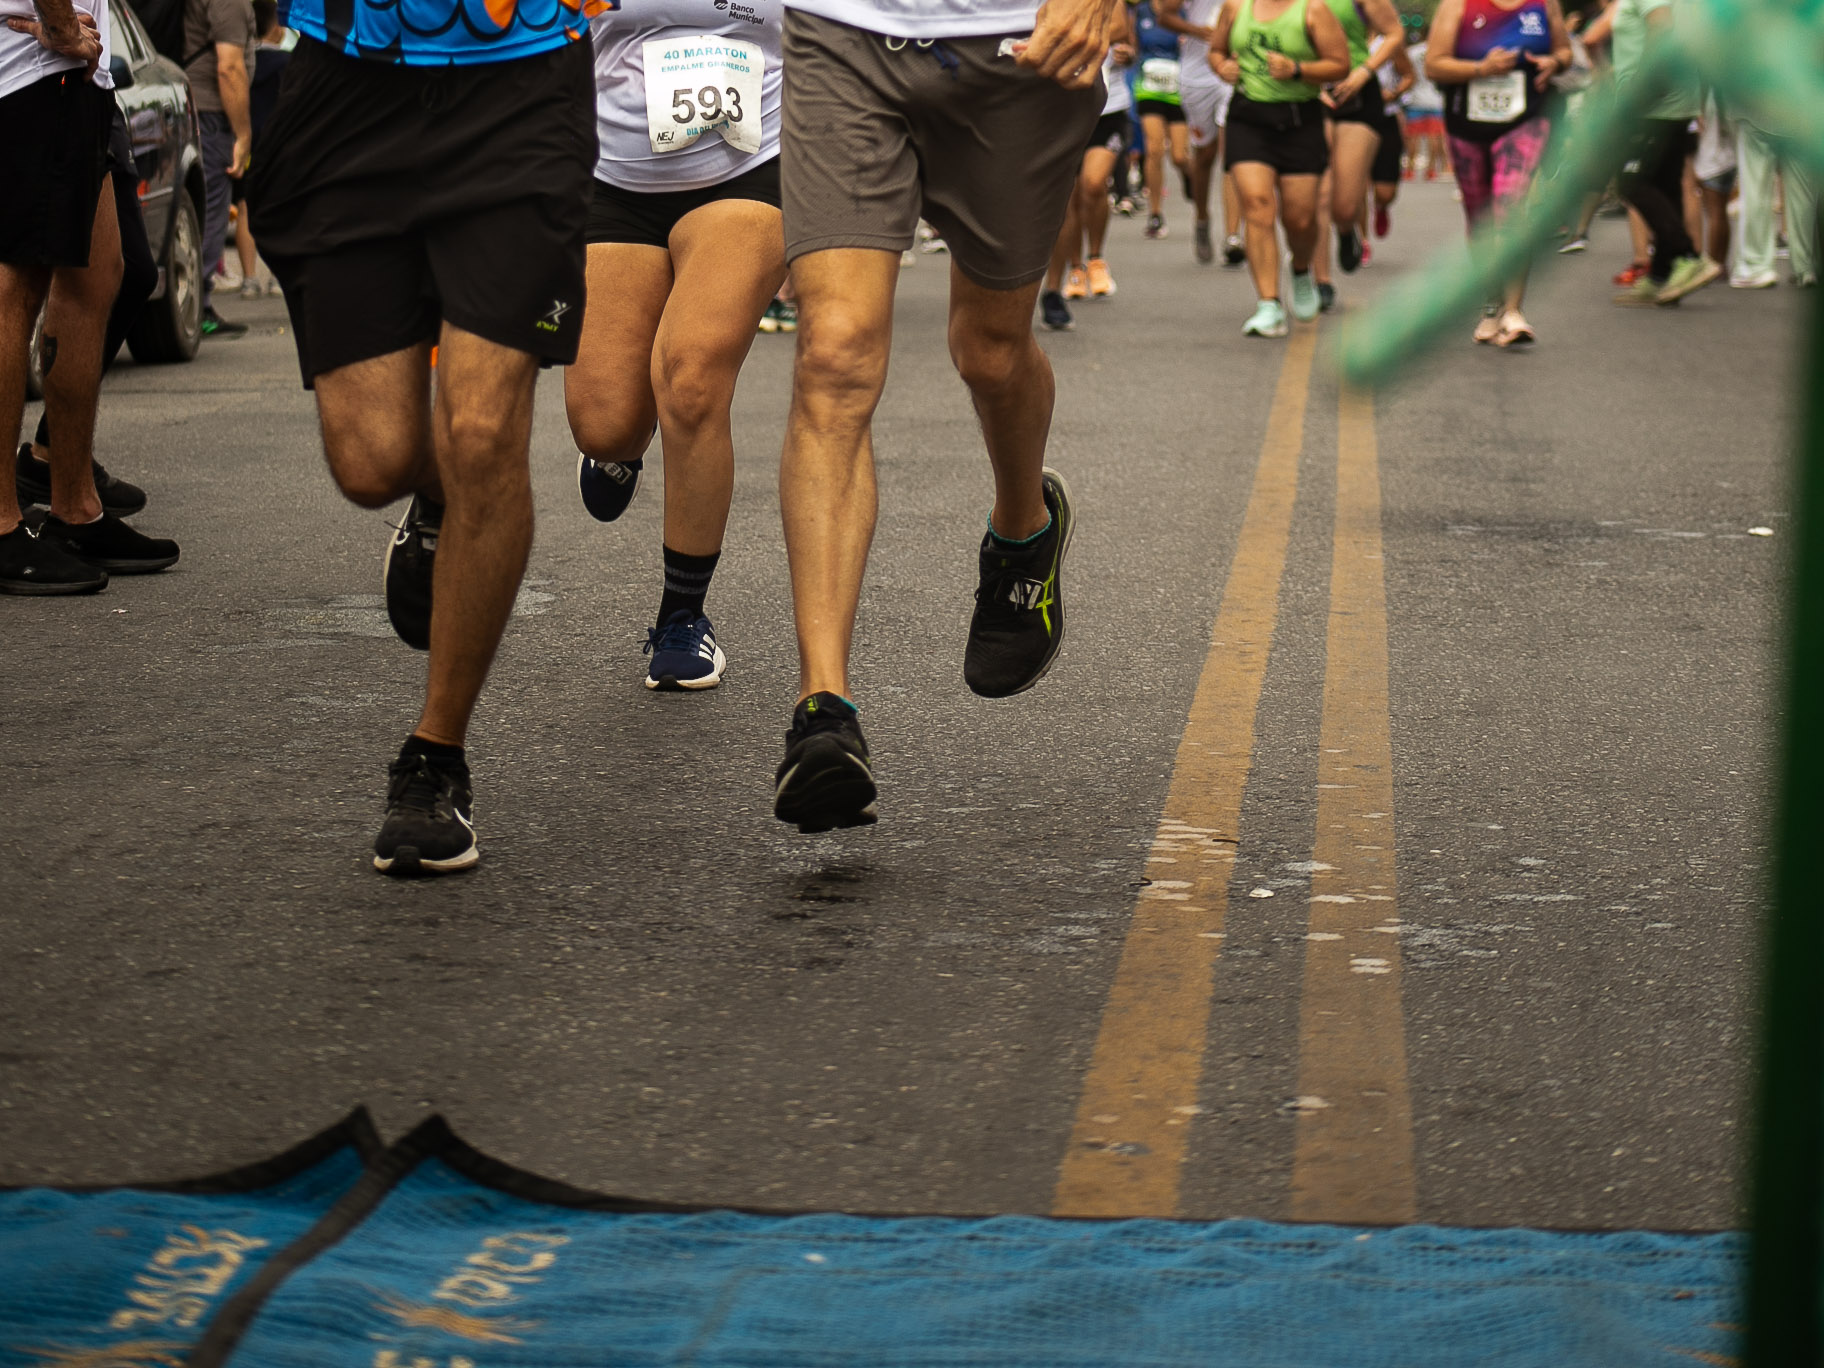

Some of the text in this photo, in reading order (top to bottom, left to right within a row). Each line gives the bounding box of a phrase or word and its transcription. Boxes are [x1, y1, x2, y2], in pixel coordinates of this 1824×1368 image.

[731, 2, 754, 14] Banco
[729, 11, 765, 25] Municipal
[664, 47, 748, 60] 40 MARATON
[661, 61, 750, 72] EMPALME GRANEROS
[672, 85, 743, 124] 593
[657, 131, 675, 142] NEJ
[686, 128, 699, 136] DIA
